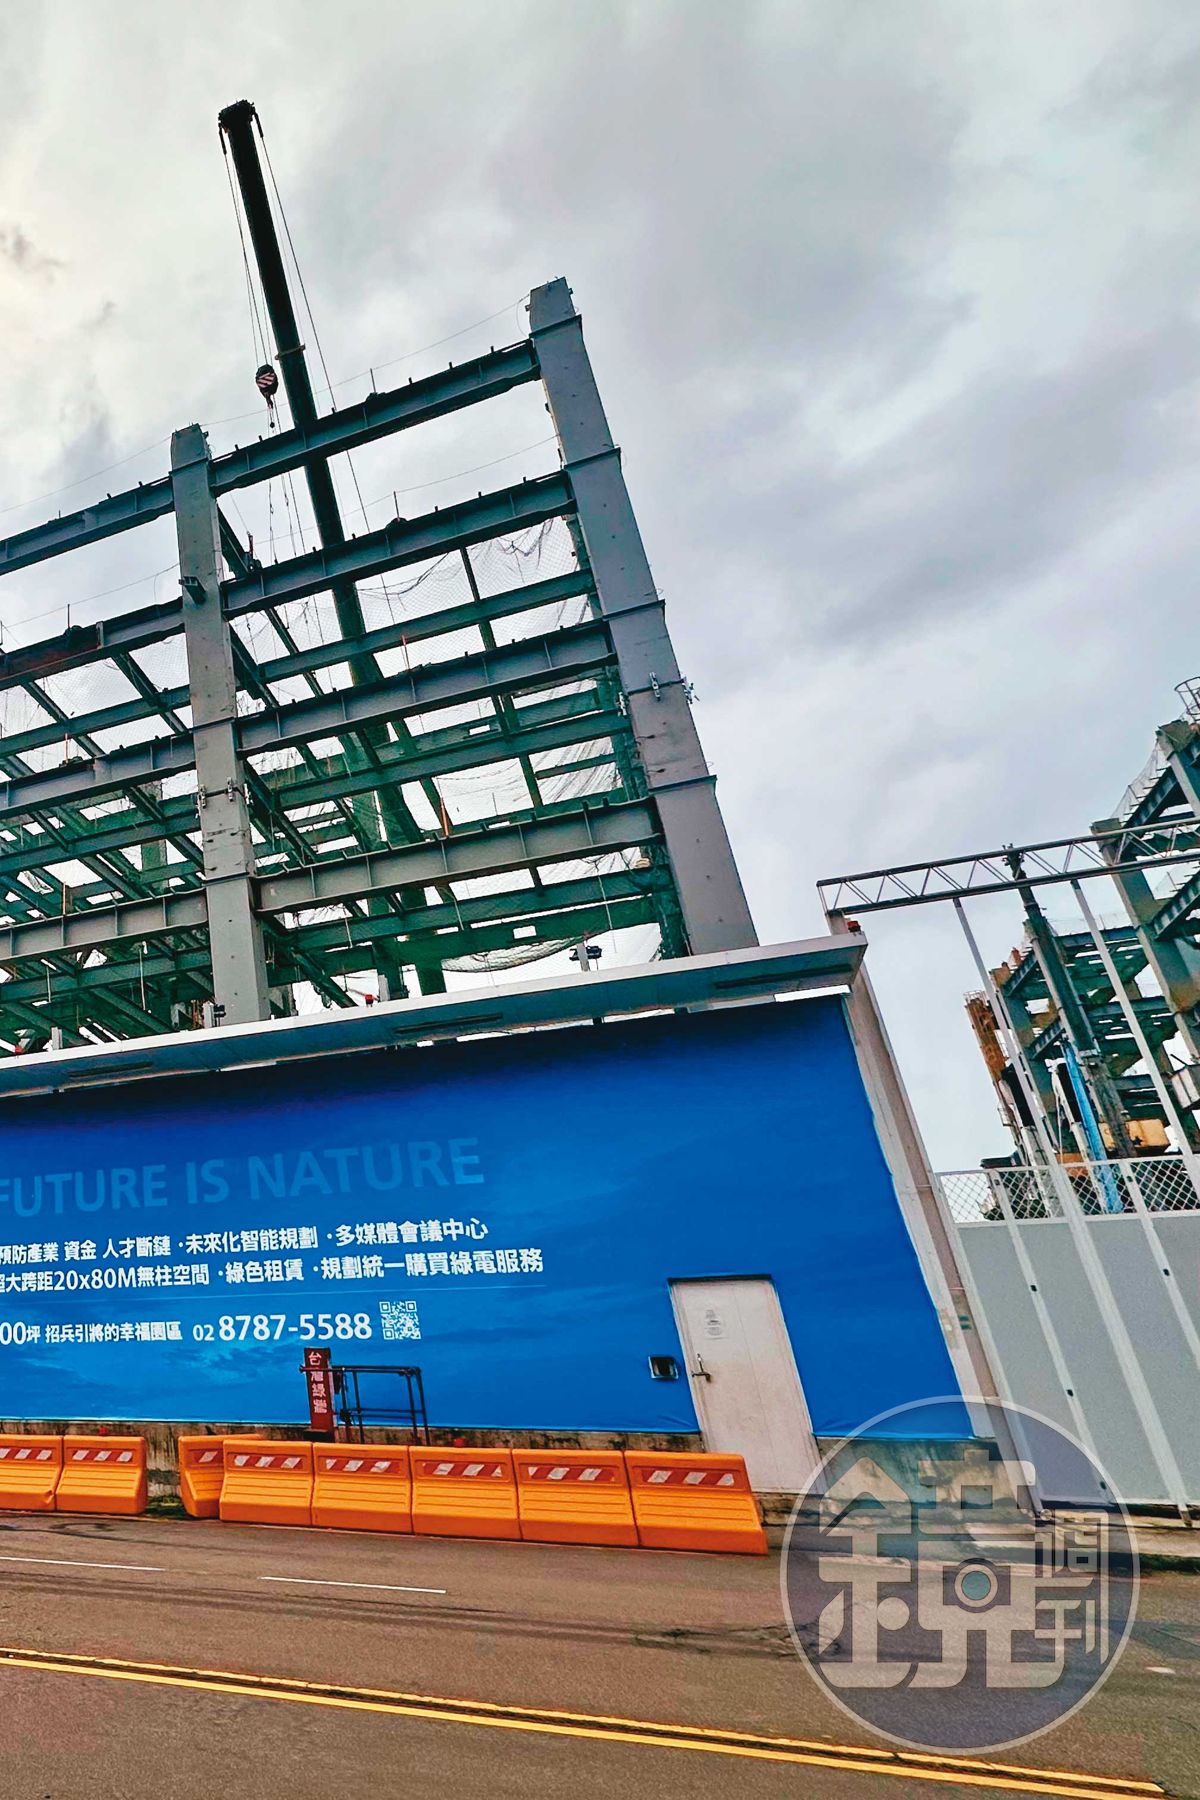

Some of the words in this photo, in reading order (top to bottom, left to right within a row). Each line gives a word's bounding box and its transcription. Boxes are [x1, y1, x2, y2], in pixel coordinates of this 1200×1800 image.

[186, 1159, 229, 1204] IS
[248, 1137, 485, 1200] NATURE
[64, 1239, 97, 1261] 資金
[45, 1321, 183, 1343] 招兵引將的幸福園區
[192, 1324, 215, 1342] 02
[218, 1313, 372, 1341] 8787-5588
